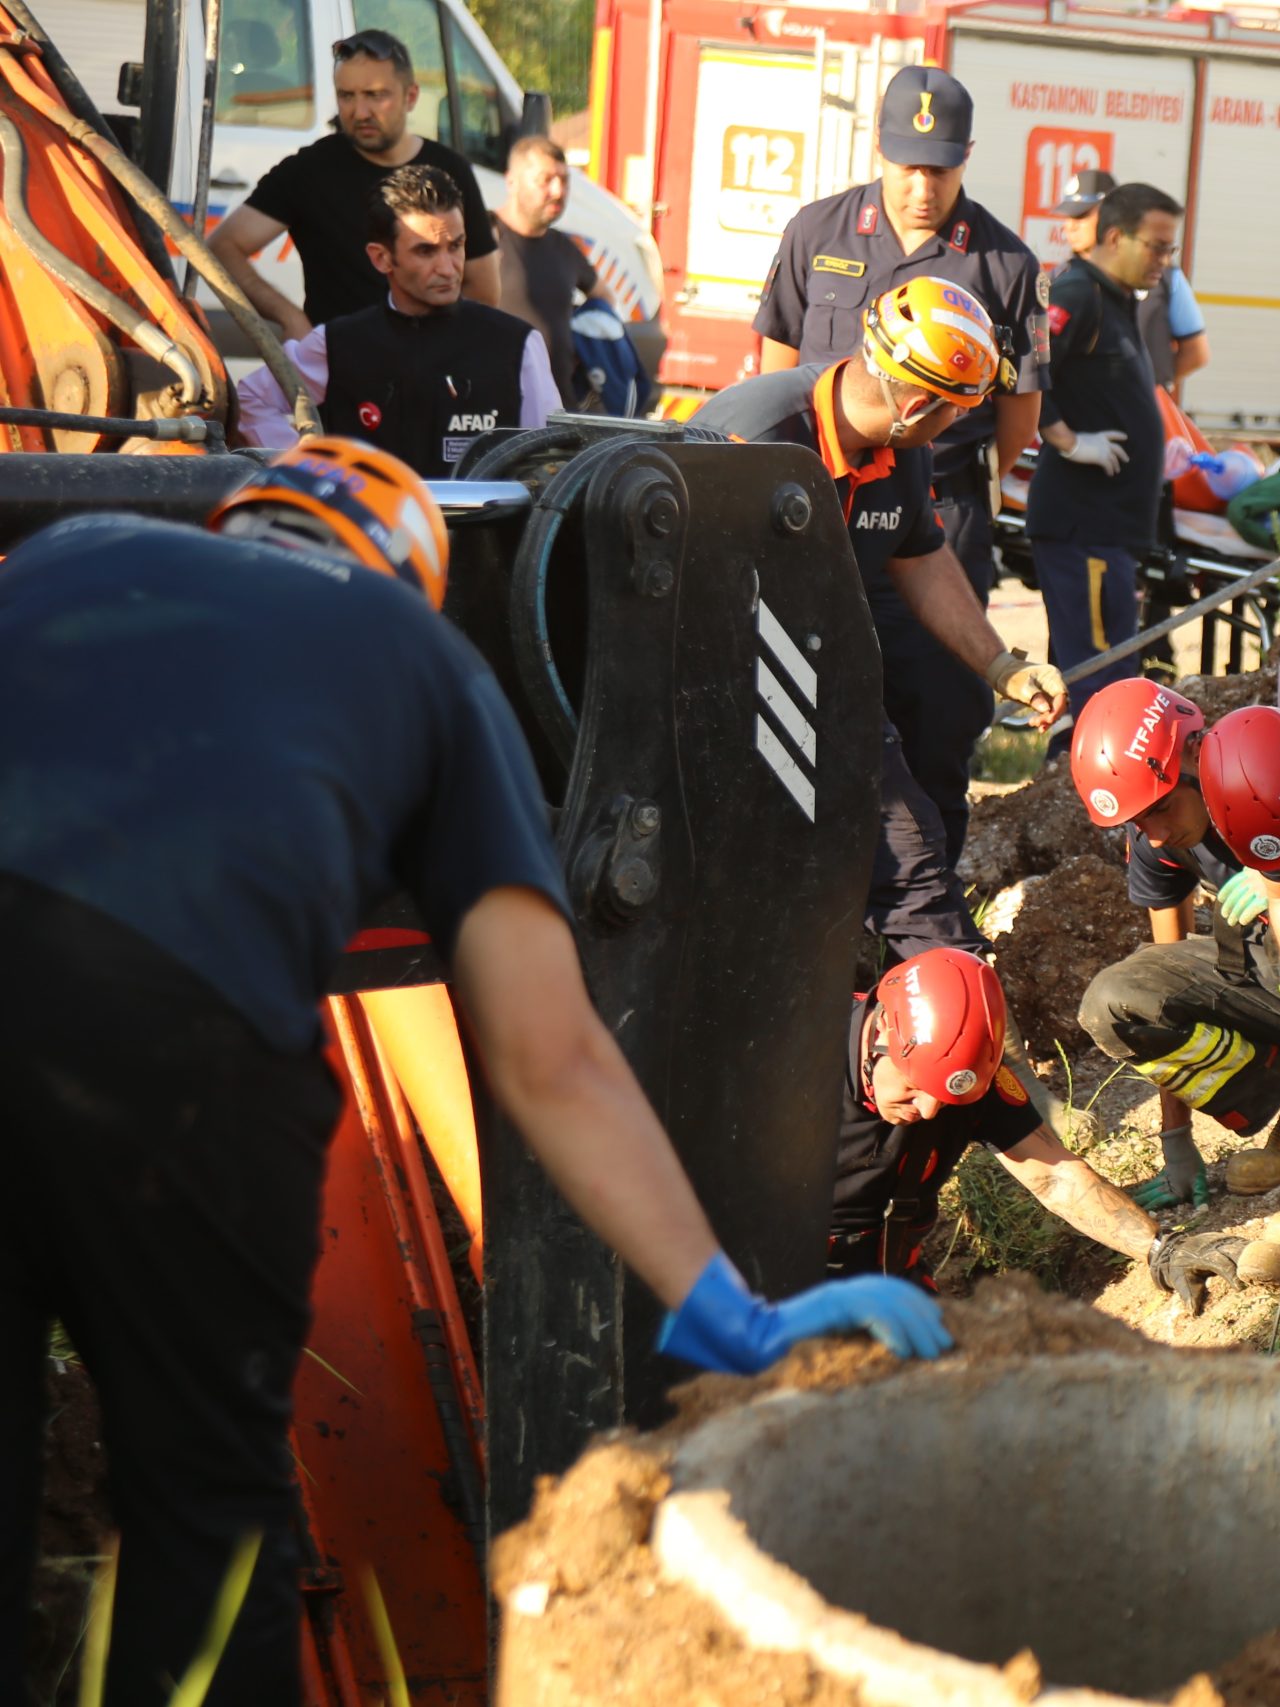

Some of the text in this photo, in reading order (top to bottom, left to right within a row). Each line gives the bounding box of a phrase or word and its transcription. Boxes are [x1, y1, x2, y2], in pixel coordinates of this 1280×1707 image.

[1010, 82, 1185, 124] KASTAMONU BELEDİYESİ
[1211, 96, 1265, 128] ARAMA
[729, 132, 796, 192] 112
[943, 289, 988, 324] FAD
[447, 413, 496, 432] AFAD
[856, 511, 900, 530] AFAD
[1124, 692, 1171, 761] İTFAİYE
